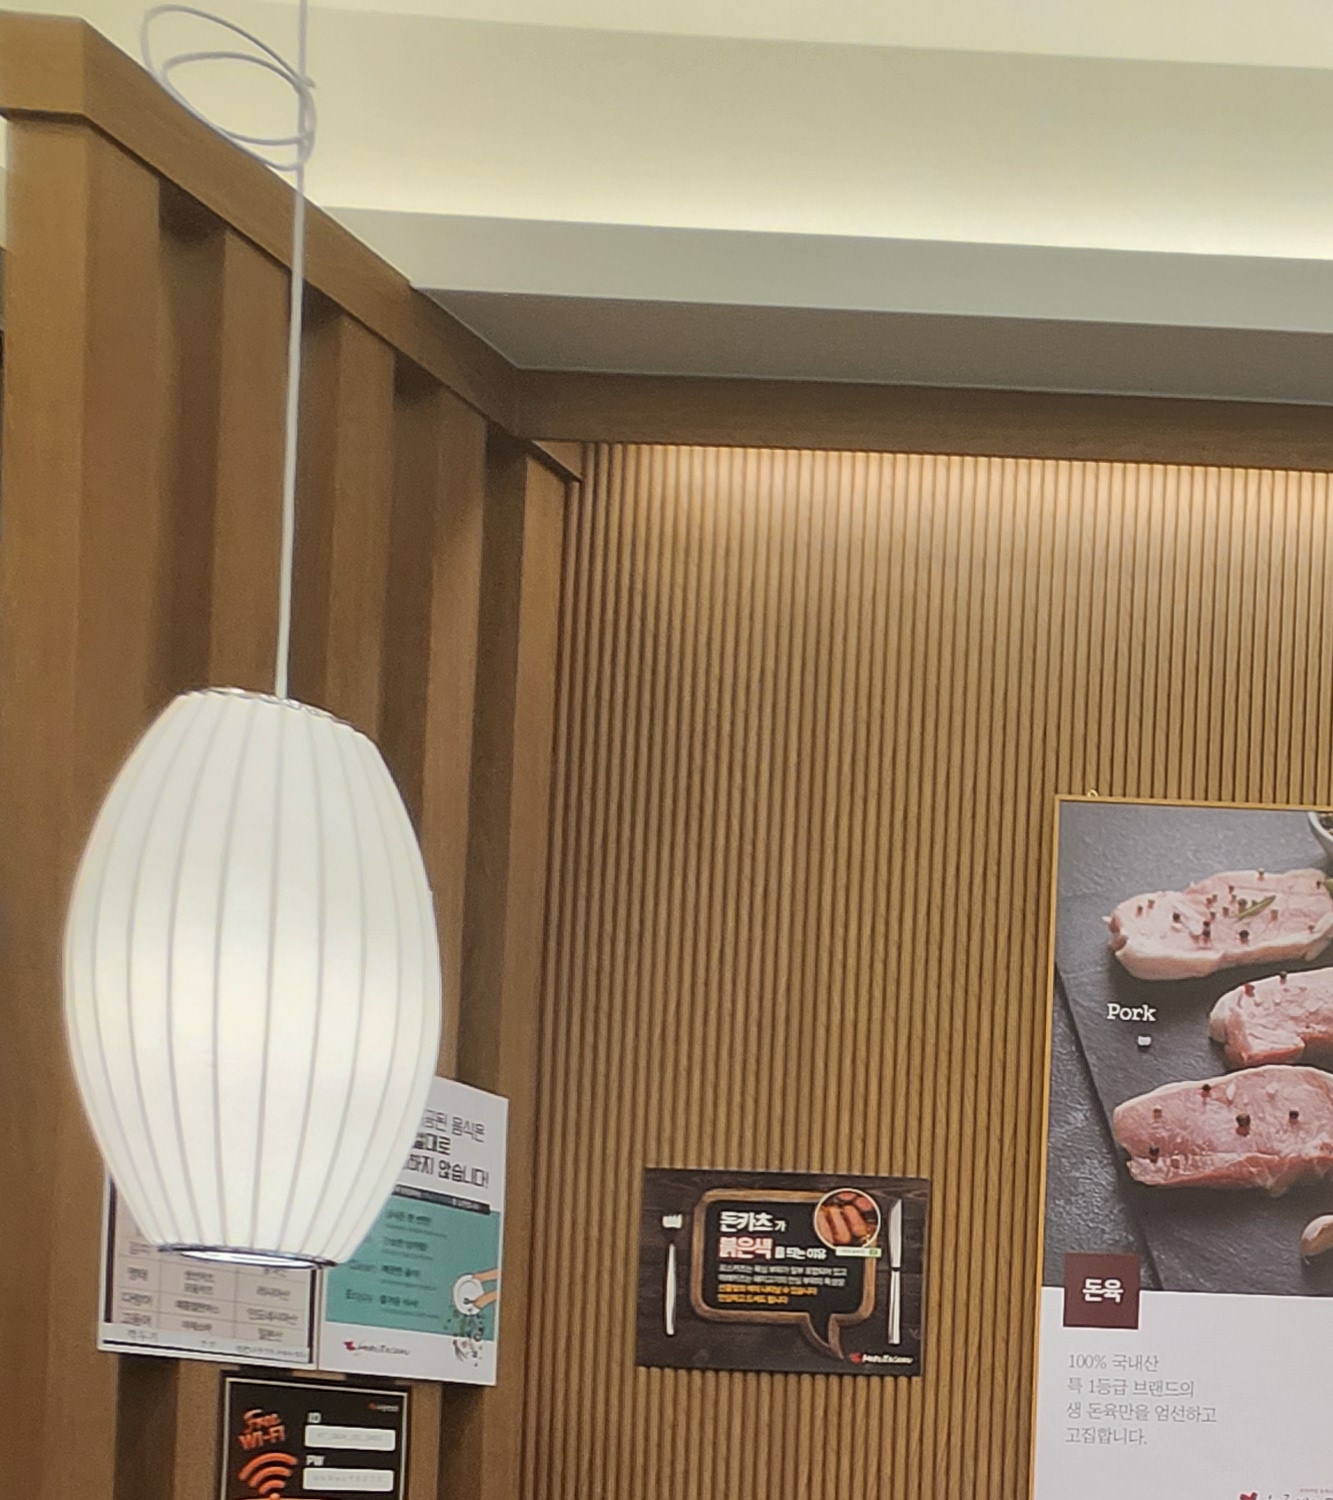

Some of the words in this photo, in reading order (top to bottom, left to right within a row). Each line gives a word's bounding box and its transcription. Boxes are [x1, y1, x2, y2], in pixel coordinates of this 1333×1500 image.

[1107, 1003, 1157, 1021] Pork
[1082, 1278, 1124, 1303] 돈육
[1069, 1354, 1107, 1369] 100%
[1112, 1353, 1159, 1372] 국내산
[1067, 1377, 1083, 1395] 특
[1089, 1378, 1128, 1396] 1등급
[1132, 1380, 1195, 1398] 브랜드의
[1066, 1402, 1082, 1419] 생
[1087, 1402, 1150, 1421] 돈육만을
[1155, 1404, 1217, 1423] 엄선하고
[1065, 1426, 1148, 1445] 고집합니다.
